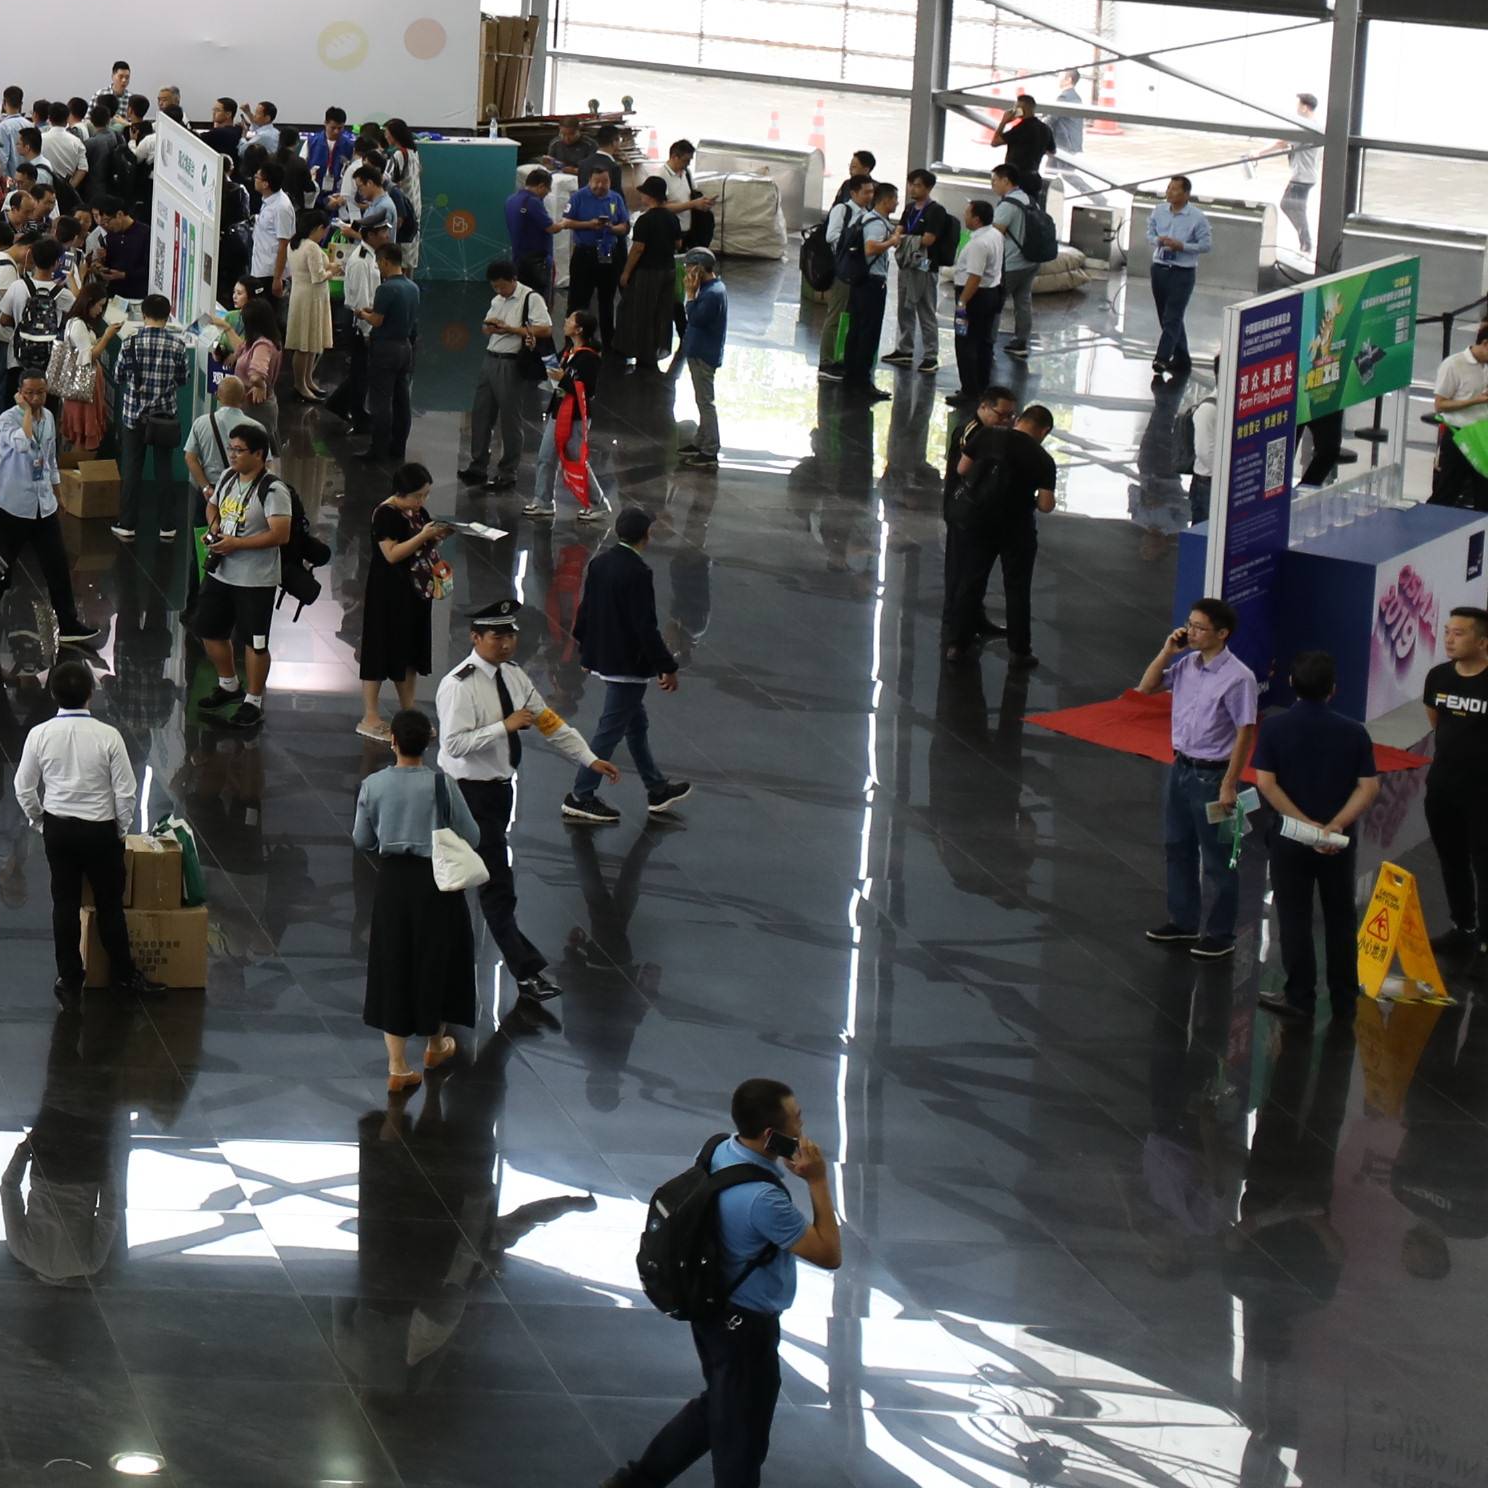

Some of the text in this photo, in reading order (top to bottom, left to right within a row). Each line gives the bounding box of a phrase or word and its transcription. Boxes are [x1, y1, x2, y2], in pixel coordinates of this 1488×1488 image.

[1238, 382, 1293, 411] Form Filling Counter
[1379, 584, 1418, 659] 2019
[1435, 693, 1488, 715] FENDI
